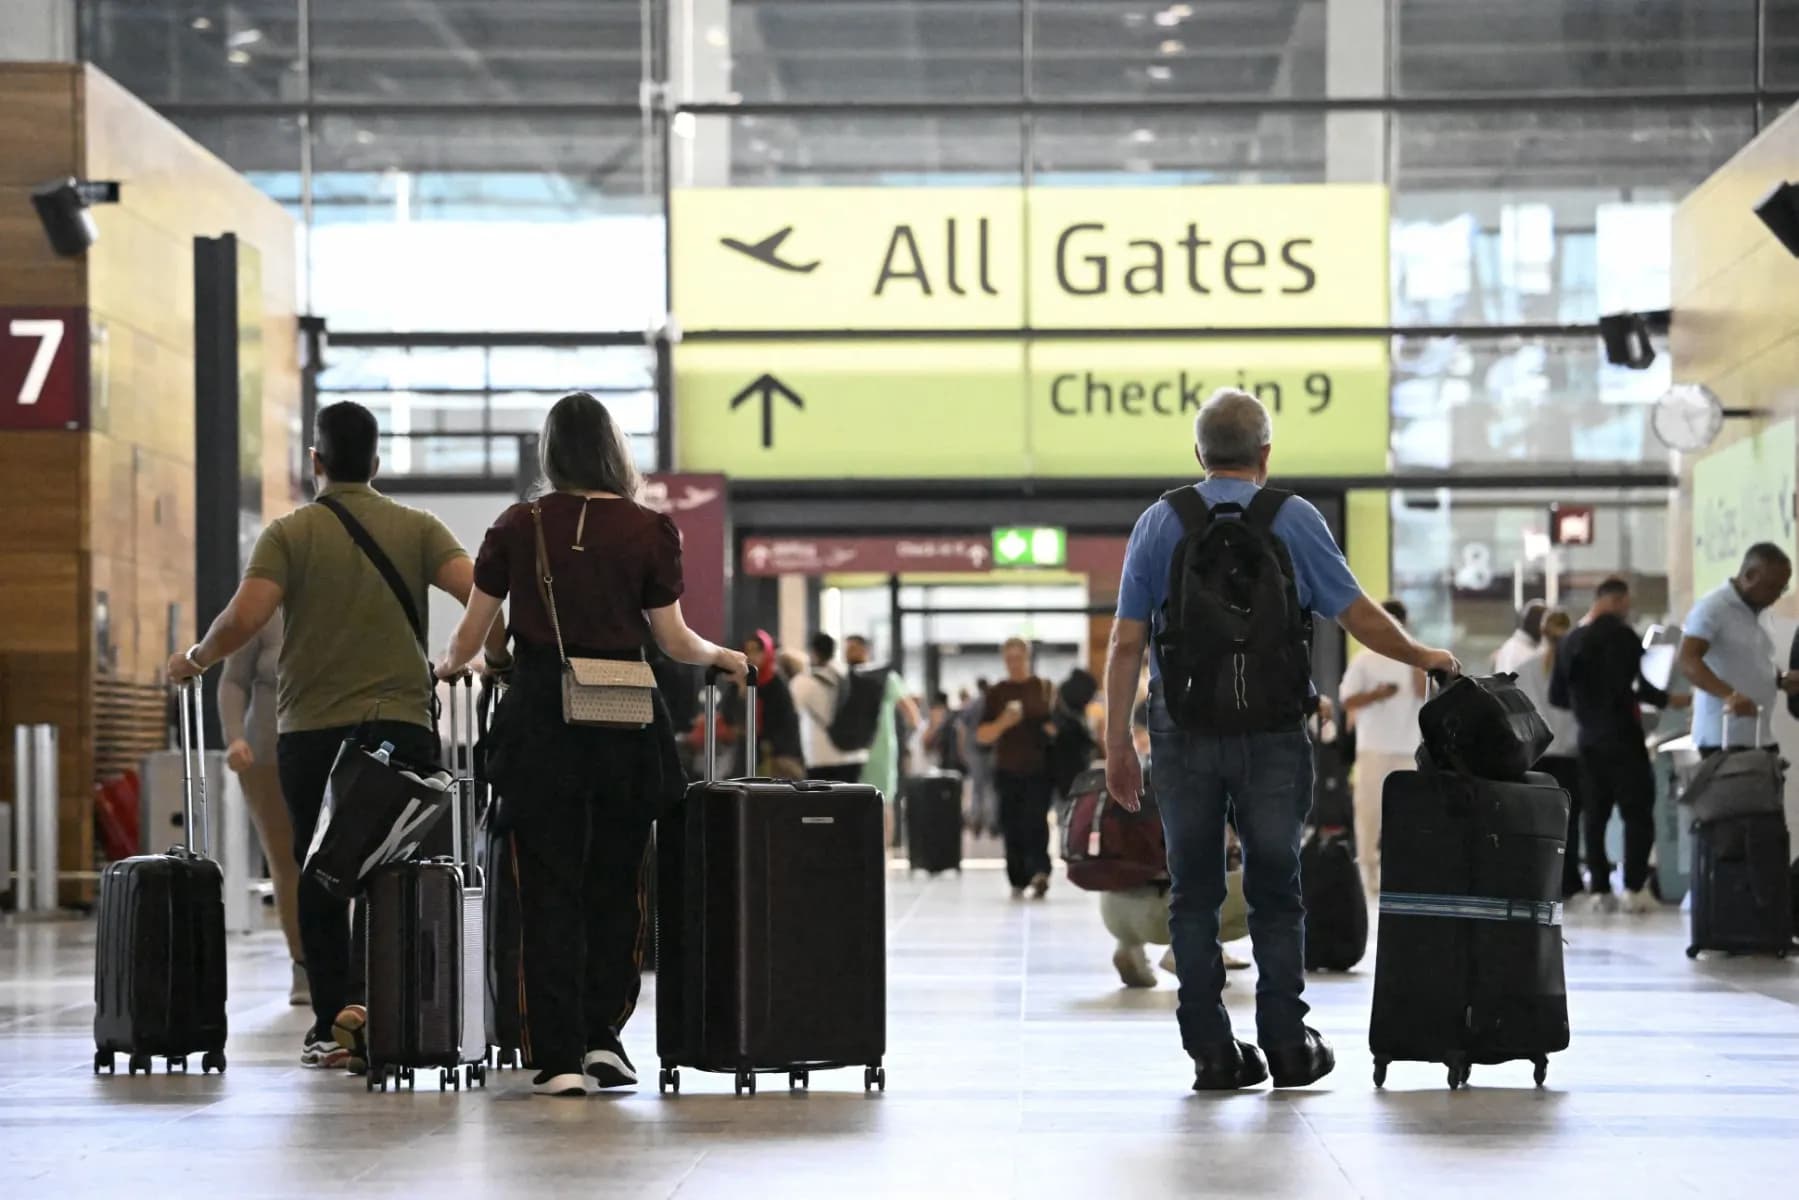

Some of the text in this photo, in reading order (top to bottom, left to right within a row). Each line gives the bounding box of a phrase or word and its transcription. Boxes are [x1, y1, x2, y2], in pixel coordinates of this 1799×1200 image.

[873, 217, 1317, 296] All Gates
[9, 319, 65, 405] 7
[1304, 371, 1333, 415] 9
